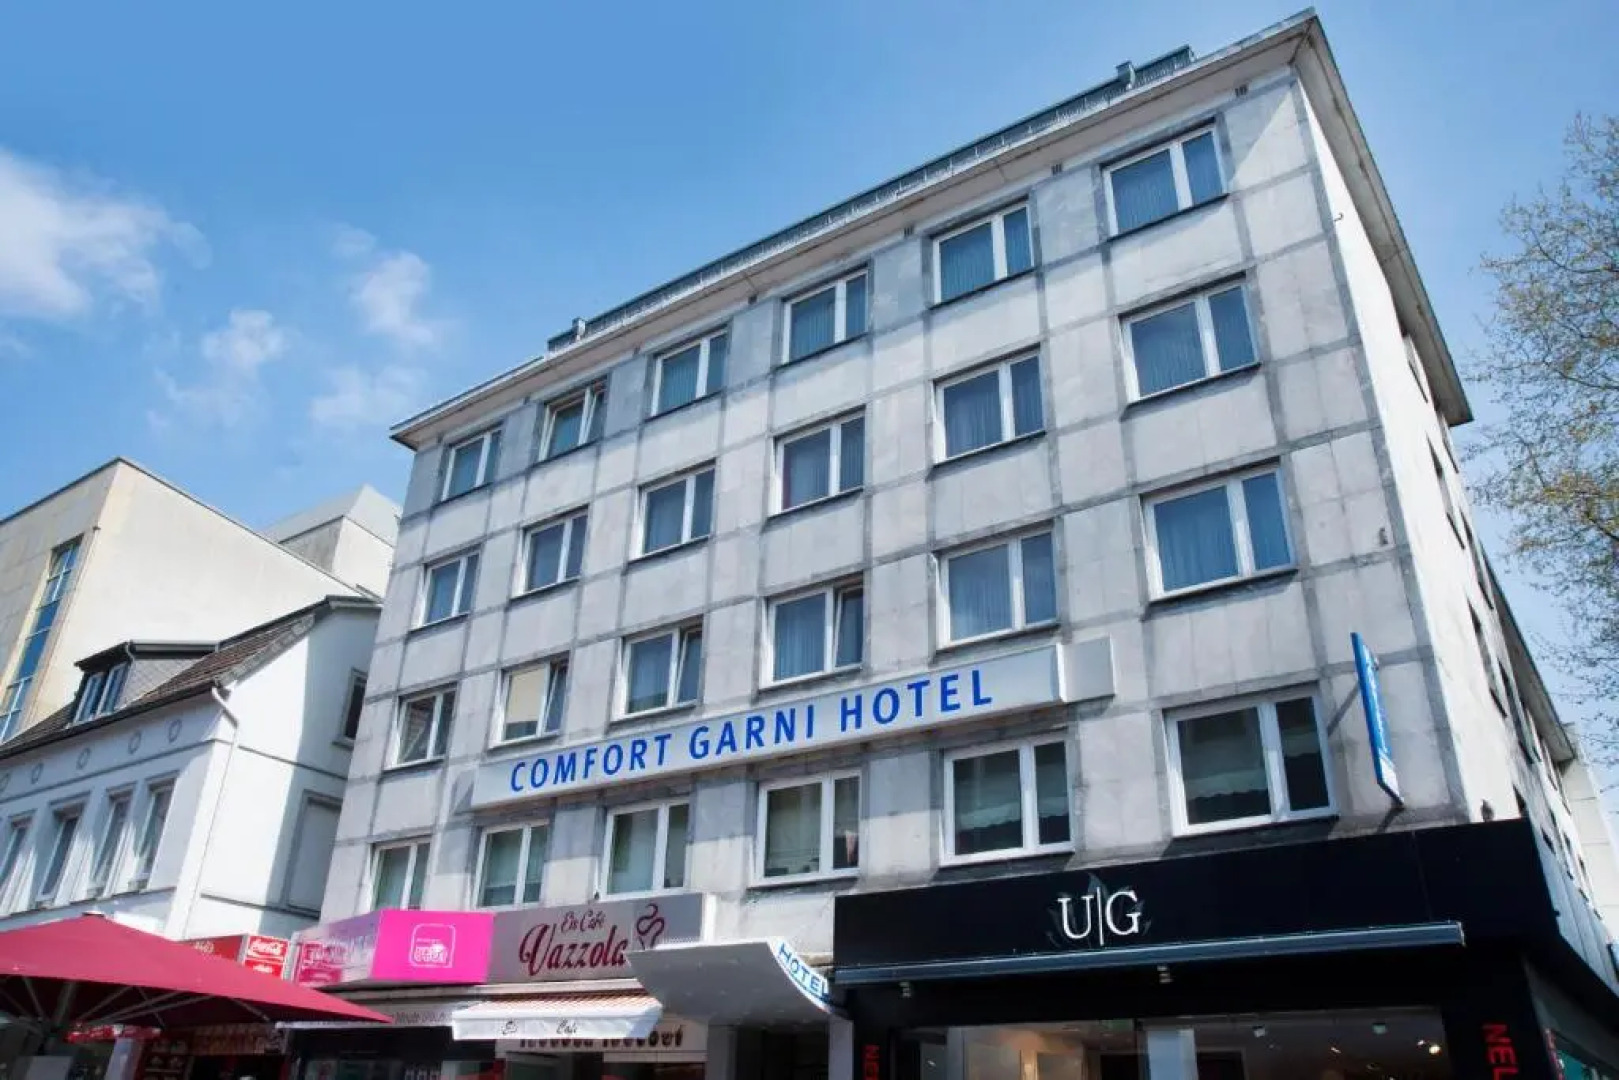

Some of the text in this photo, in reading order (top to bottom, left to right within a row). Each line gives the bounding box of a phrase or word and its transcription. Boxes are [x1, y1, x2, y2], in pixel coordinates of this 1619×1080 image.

[510, 668, 993, 793] COMFORT GARNI HOTEL
[518, 923, 629, 977] Vazzola
[779, 942, 829, 998] HOTEL
